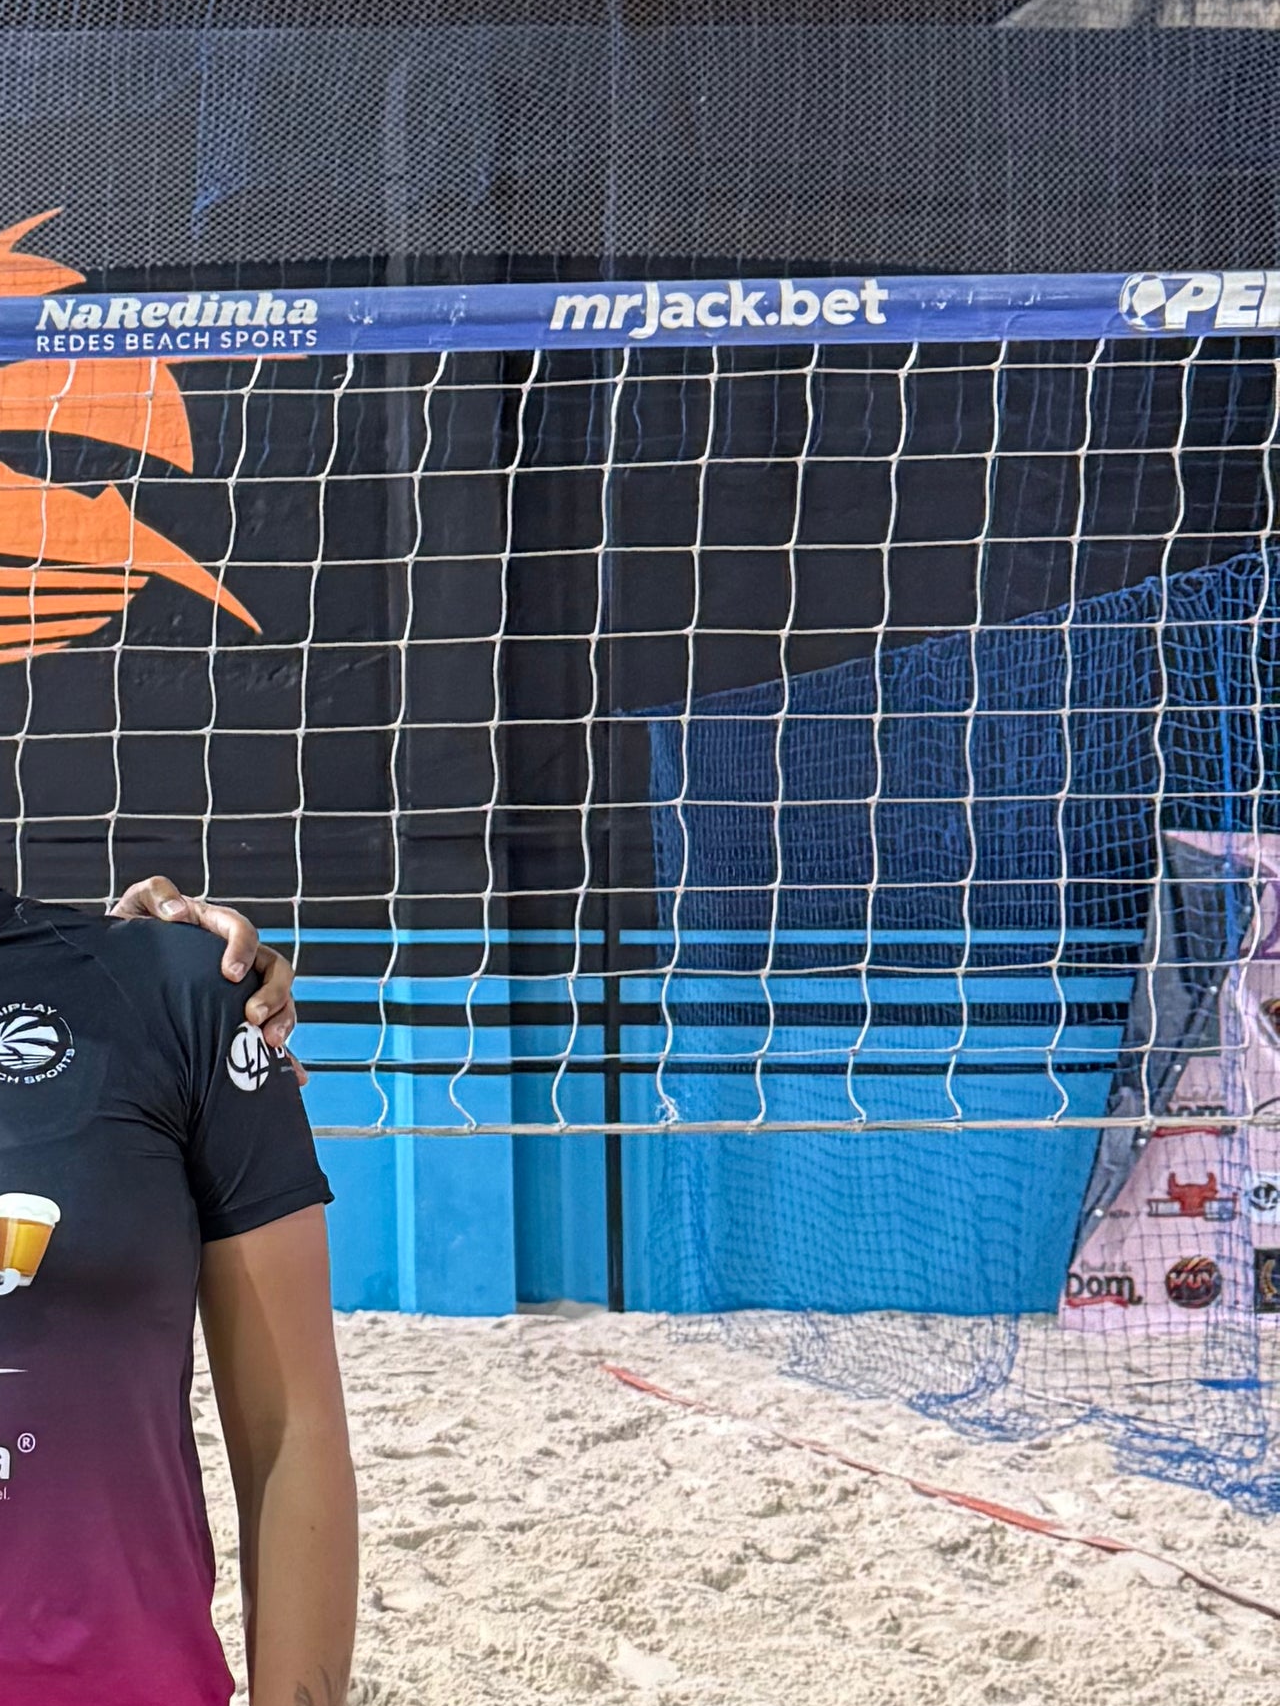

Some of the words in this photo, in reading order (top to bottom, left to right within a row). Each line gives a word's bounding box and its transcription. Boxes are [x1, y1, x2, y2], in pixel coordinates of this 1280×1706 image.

[35, 292, 318, 330] NaRedinha
[37, 334, 114, 352] REDES
[125, 332, 210, 351] BEACH
[220, 329, 318, 348] SPORTS
